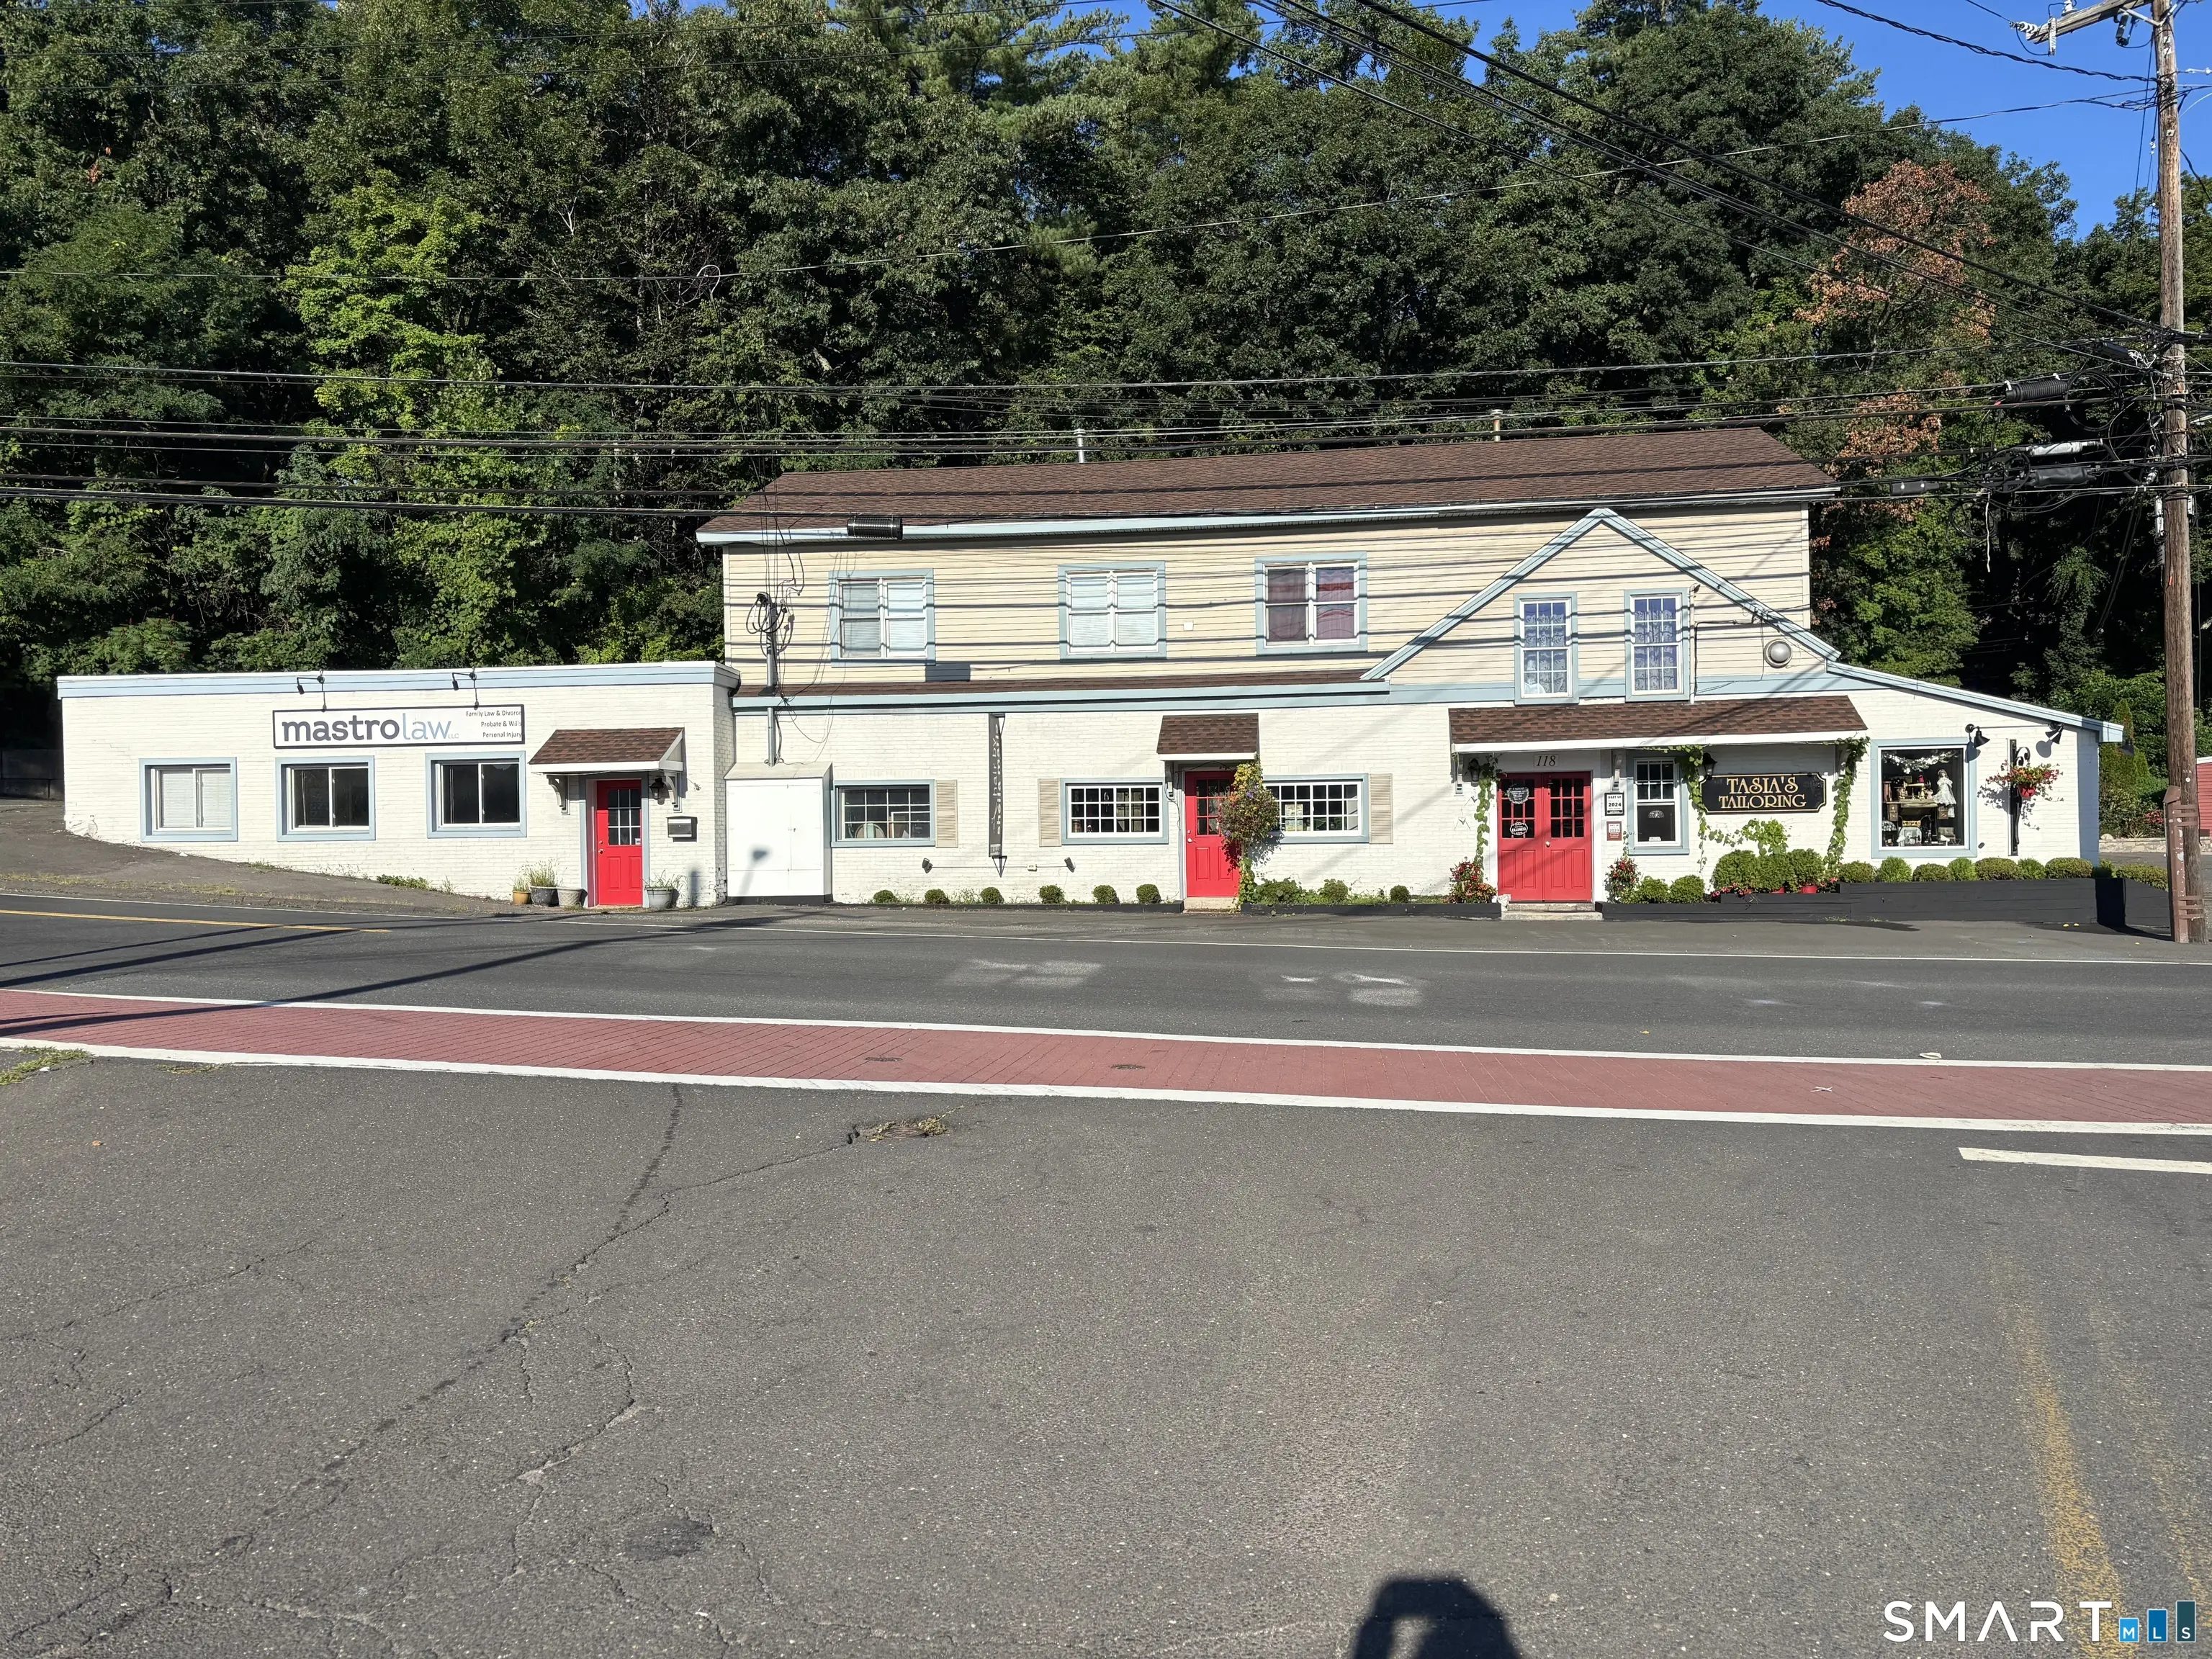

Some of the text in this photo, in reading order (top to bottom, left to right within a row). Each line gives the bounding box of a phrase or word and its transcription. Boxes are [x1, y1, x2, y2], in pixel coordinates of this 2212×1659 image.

[282, 713, 451, 742] mastrolaw
[992, 738, 997, 757] by
[1536, 755, 1556, 767] 118
[1726, 776, 1799, 794] TASIA'S
[1718, 793, 1807, 809] TAILORING
